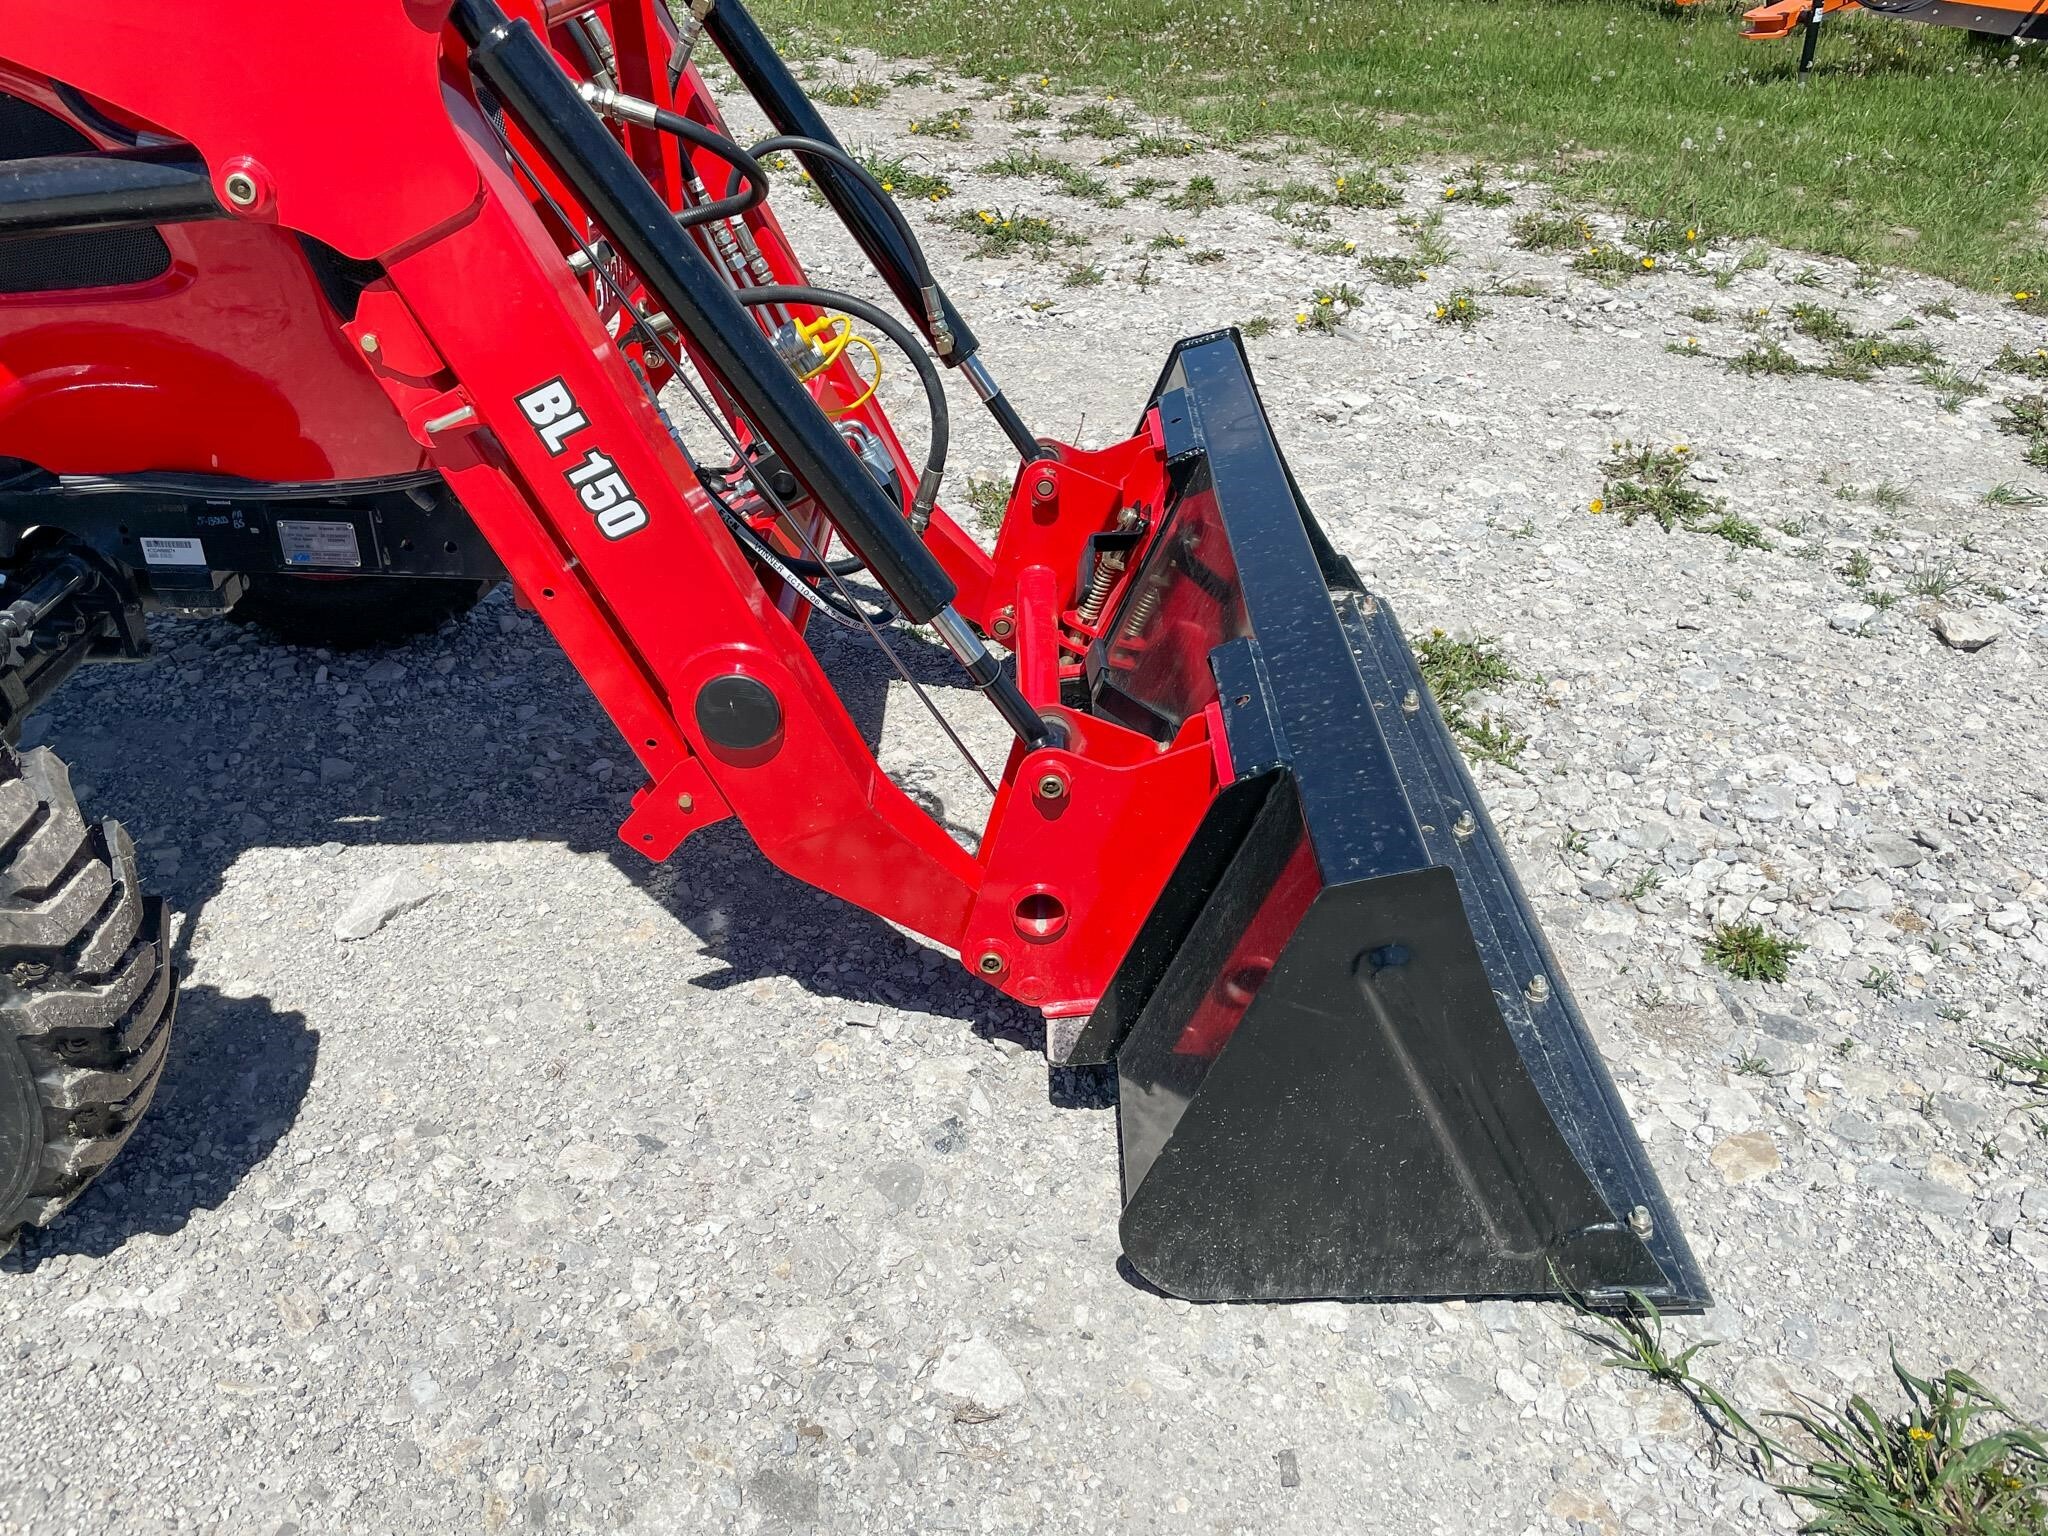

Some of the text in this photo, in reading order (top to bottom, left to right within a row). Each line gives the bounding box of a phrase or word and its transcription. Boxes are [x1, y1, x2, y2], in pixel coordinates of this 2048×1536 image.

[516, 378, 648, 539] BL 150
[754, 541, 784, 573] WINNER
